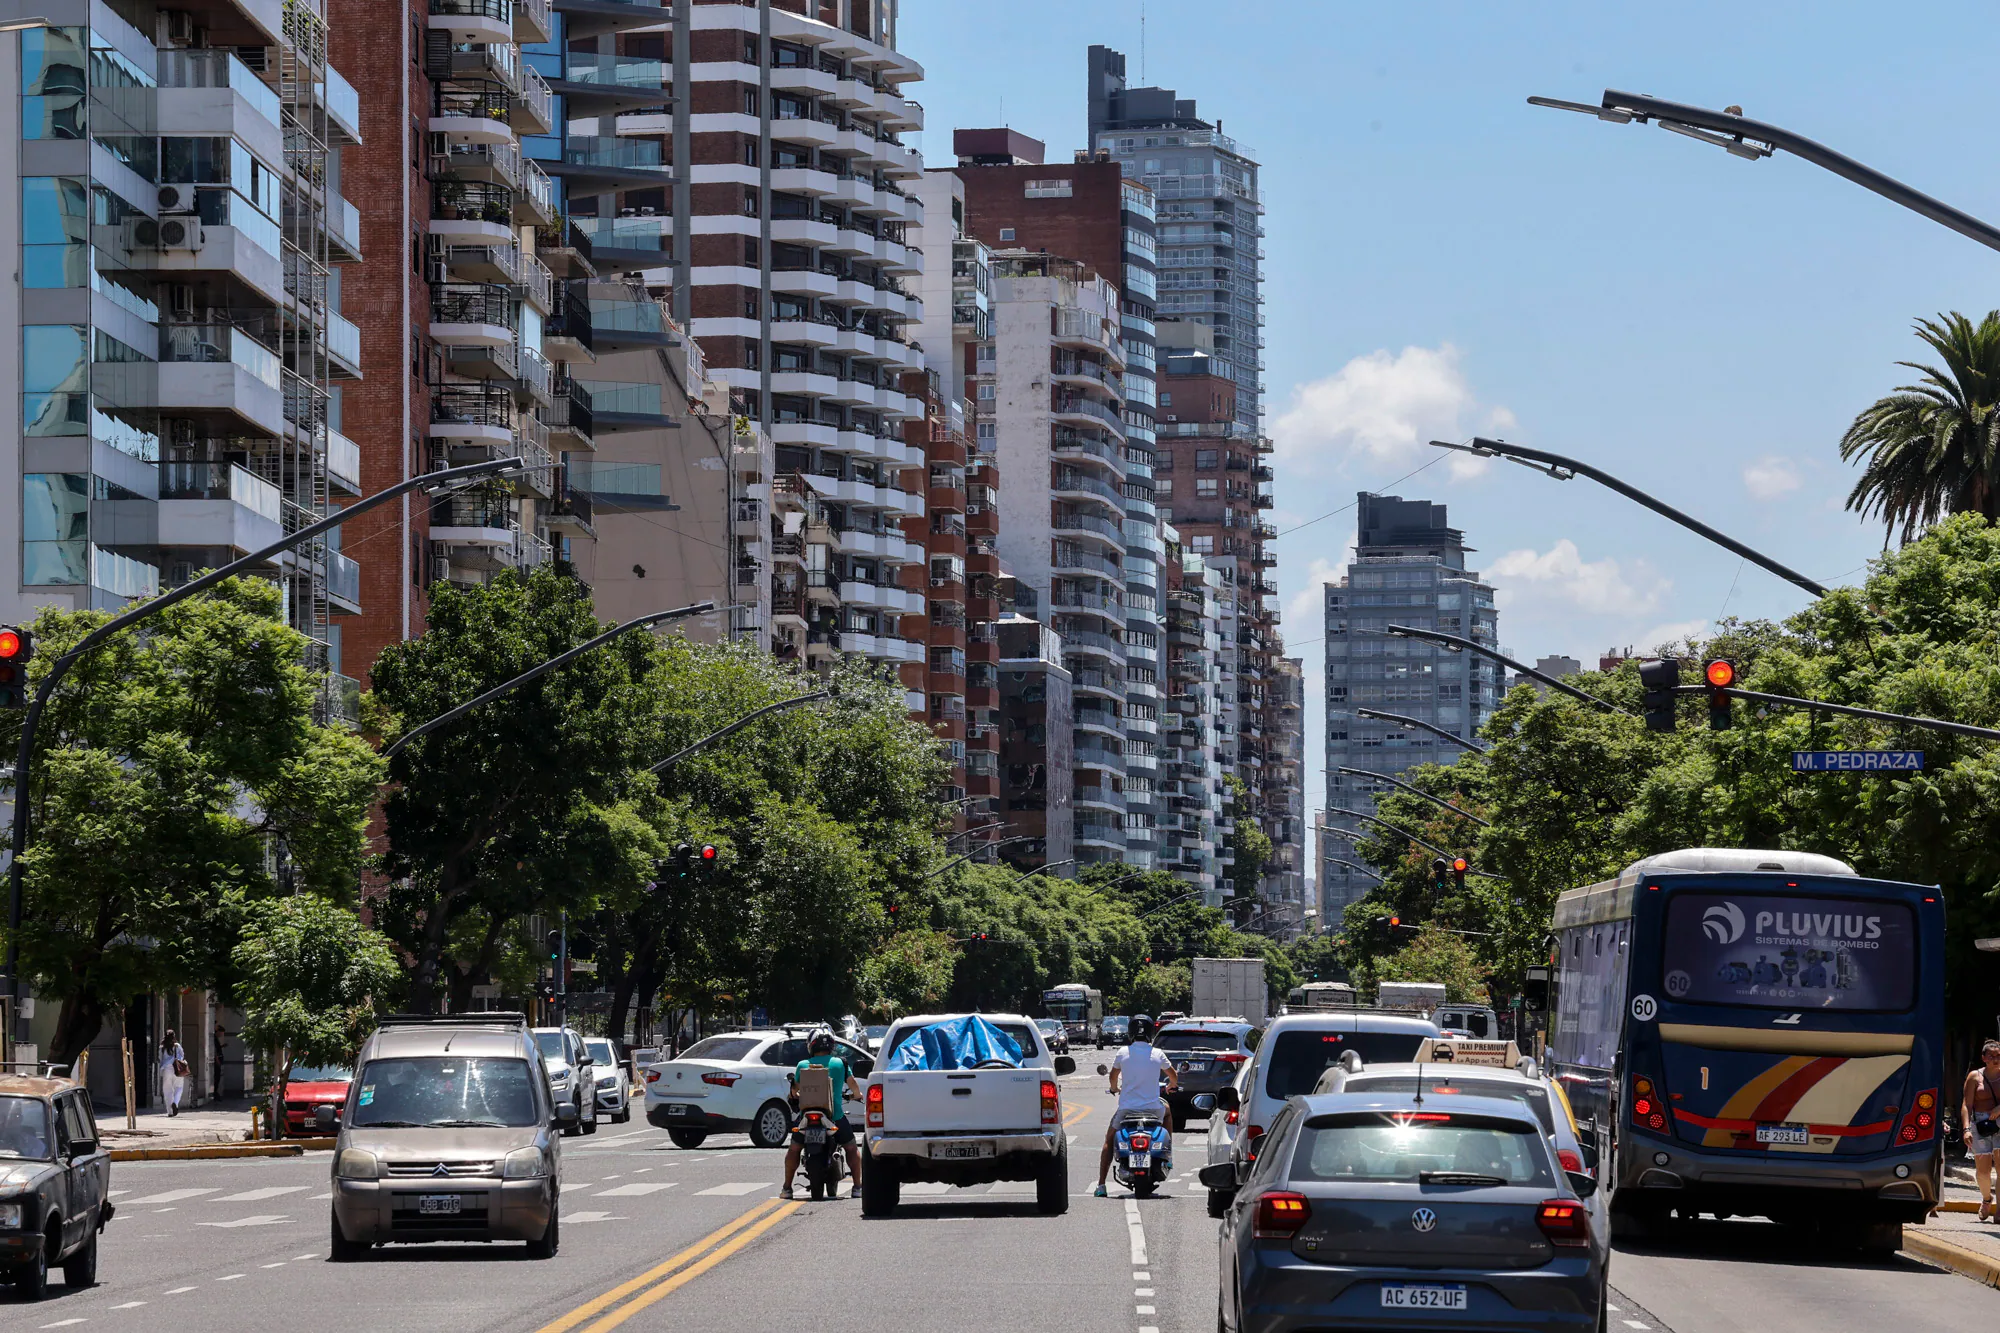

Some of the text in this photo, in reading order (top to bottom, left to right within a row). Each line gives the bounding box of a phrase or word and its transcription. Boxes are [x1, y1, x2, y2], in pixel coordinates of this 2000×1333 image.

[1797, 753, 1919, 769] M. PEDRAZA
[1755, 911, 1882, 939] PLUVIUS
[1755, 936, 1880, 950] SISTEMAS DE BOMBEO
[1668, 975, 1688, 992] 60
[1633, 999, 1653, 1016] 60
[1474, 1043, 1507, 1051] PREMIUM
[1465, 1057, 1480, 1065] App
[1700, 1066, 1709, 1090] 1
[1758, 1131, 1805, 1142] AF 293 LE
[1385, 1289, 1463, 1307] AC 652 UF
